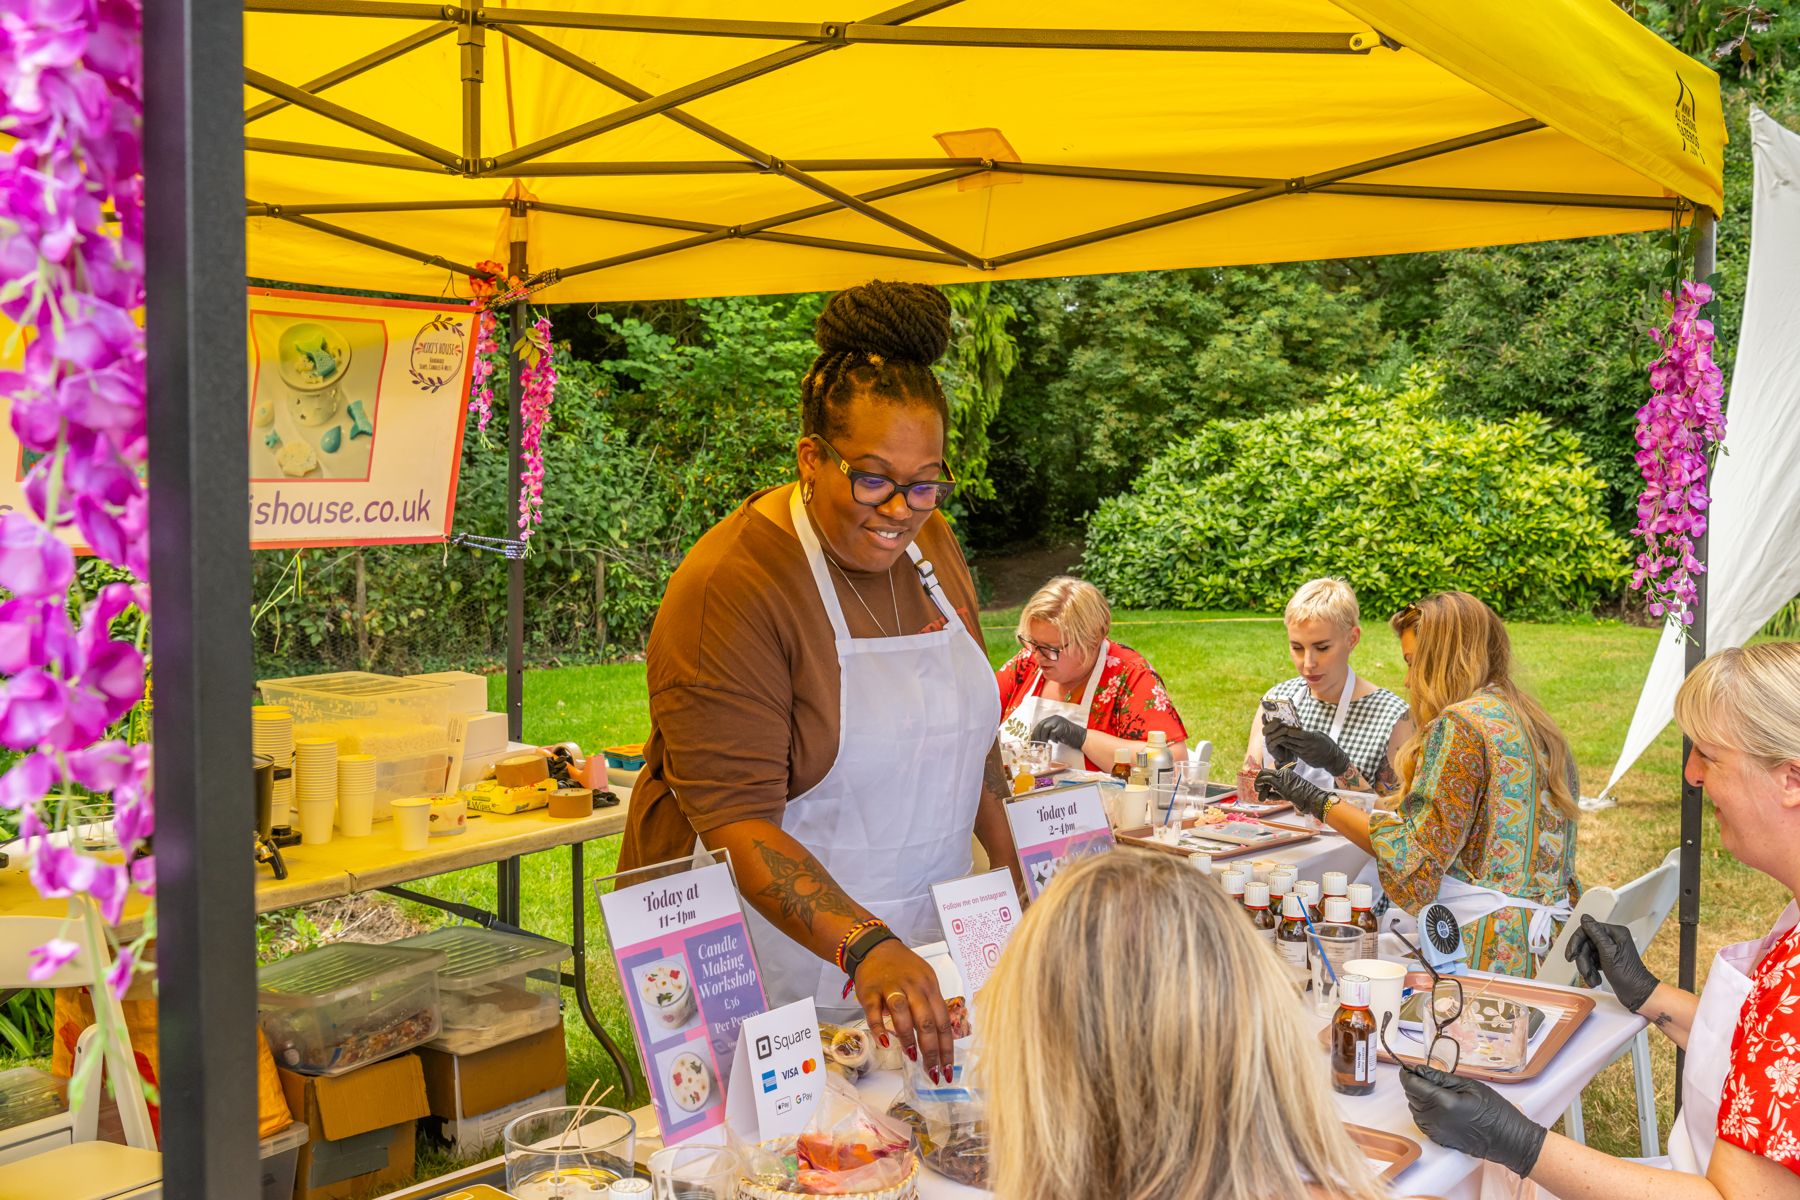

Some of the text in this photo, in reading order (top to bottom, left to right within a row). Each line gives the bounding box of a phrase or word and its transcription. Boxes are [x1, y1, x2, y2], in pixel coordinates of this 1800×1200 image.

[439, 343, 455, 356] HOUSE
[1036, 802, 1077, 822] Today at
[1049, 822, 1075, 836] 2-4pm
[643, 883, 699, 912] Today at
[942, 902, 962, 911] Follow
[979, 890, 1008, 902] Instagram
[659, 910, 696, 929] 11-1pm
[698, 934, 738, 960] Candle
[702, 953, 745, 979] Making
[698, 968, 757, 1000] Workshop
[724, 996, 740, 1010] £36
[715, 1020, 730, 1034] Per
[773, 1027, 812, 1050] Square
[781, 1066, 799, 1080] VISA
[781, 1101, 790, 1109] Pay
[802, 1092, 813, 1102] Pay
